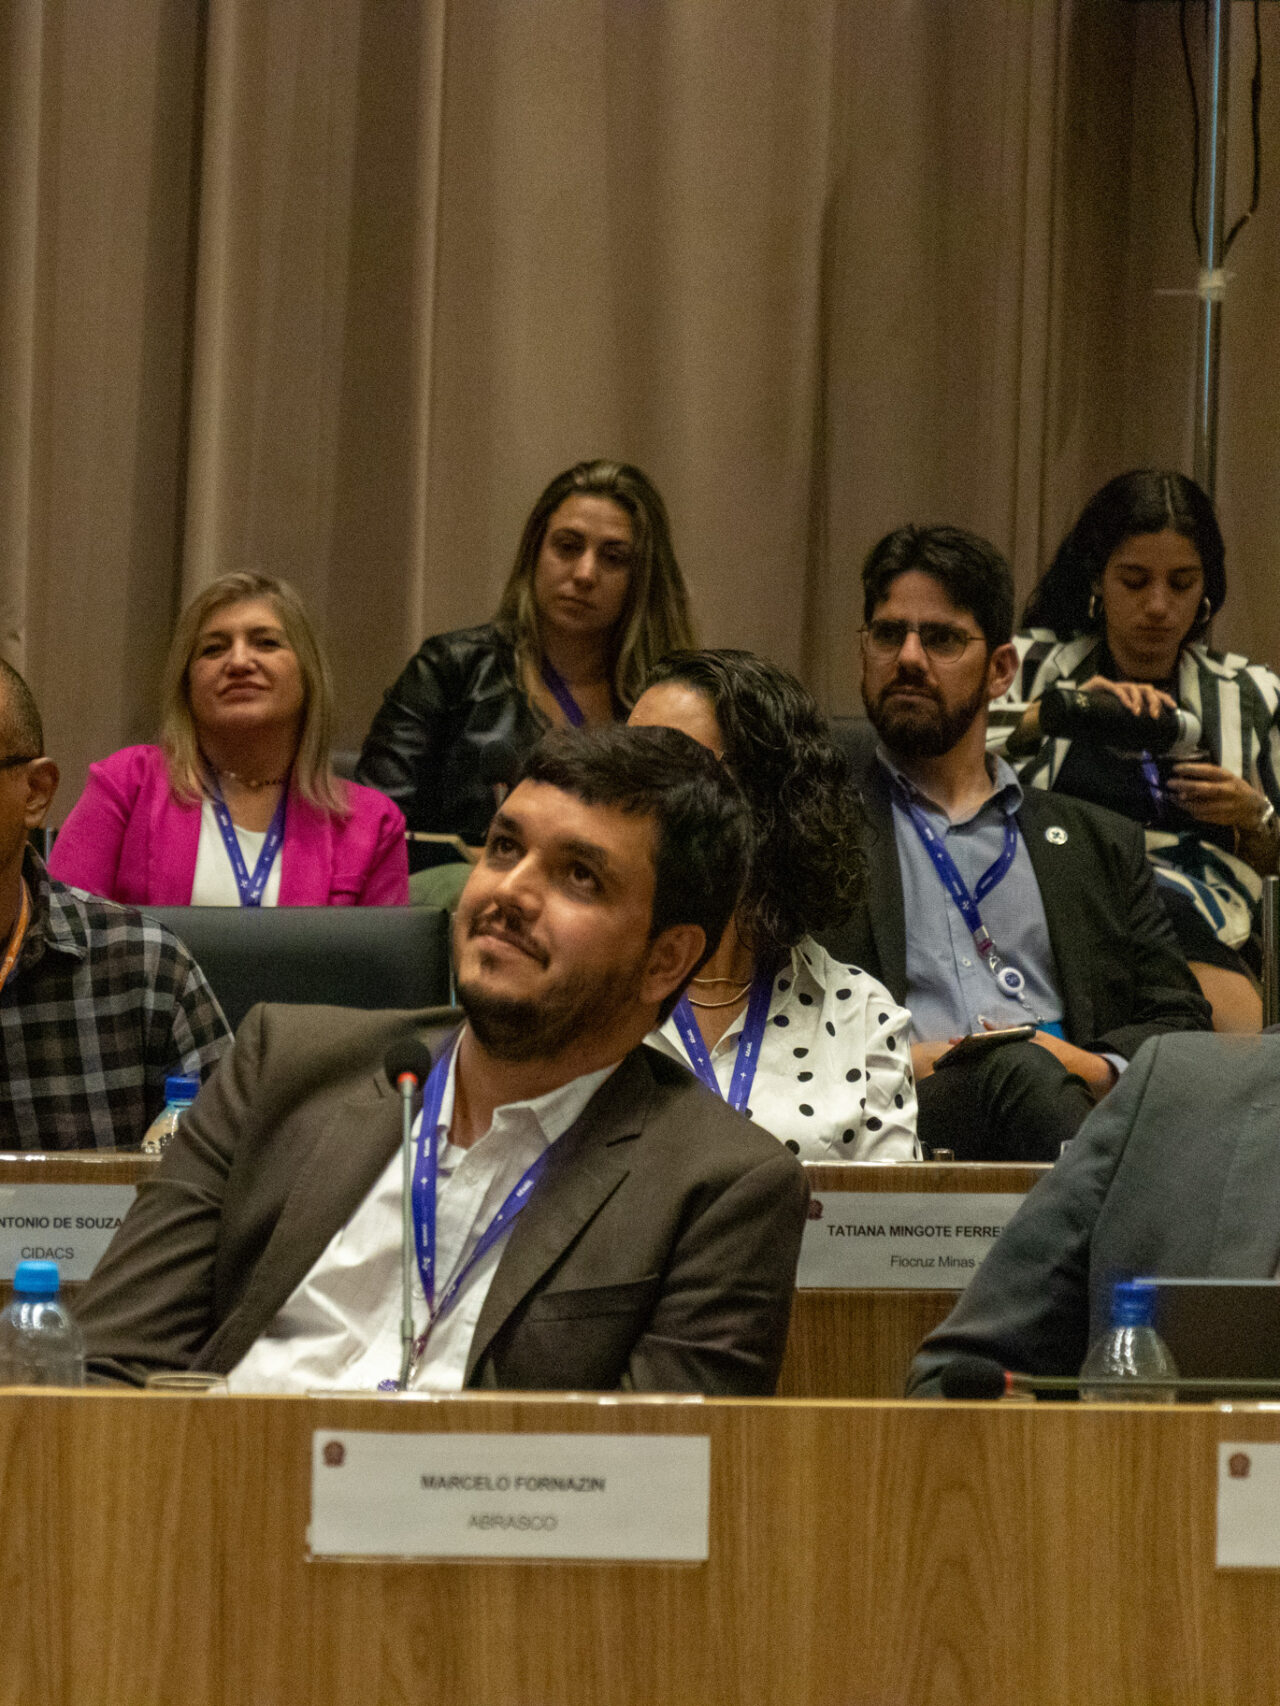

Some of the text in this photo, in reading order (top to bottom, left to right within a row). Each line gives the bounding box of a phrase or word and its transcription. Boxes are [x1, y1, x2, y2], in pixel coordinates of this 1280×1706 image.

[53, 1216, 73, 1230] DE
[75, 1216, 123, 1230] SOUZA
[826, 1224, 1005, 1238] TATIANA MINGOTE FERRE
[20, 1246, 75, 1260] CIDACS
[890, 1255, 935, 1268] Fiocruz
[938, 1255, 976, 1269] Minas
[420, 1475, 606, 1493] MARCELO FORNAZIN
[468, 1514, 559, 1532] ABRASCO
